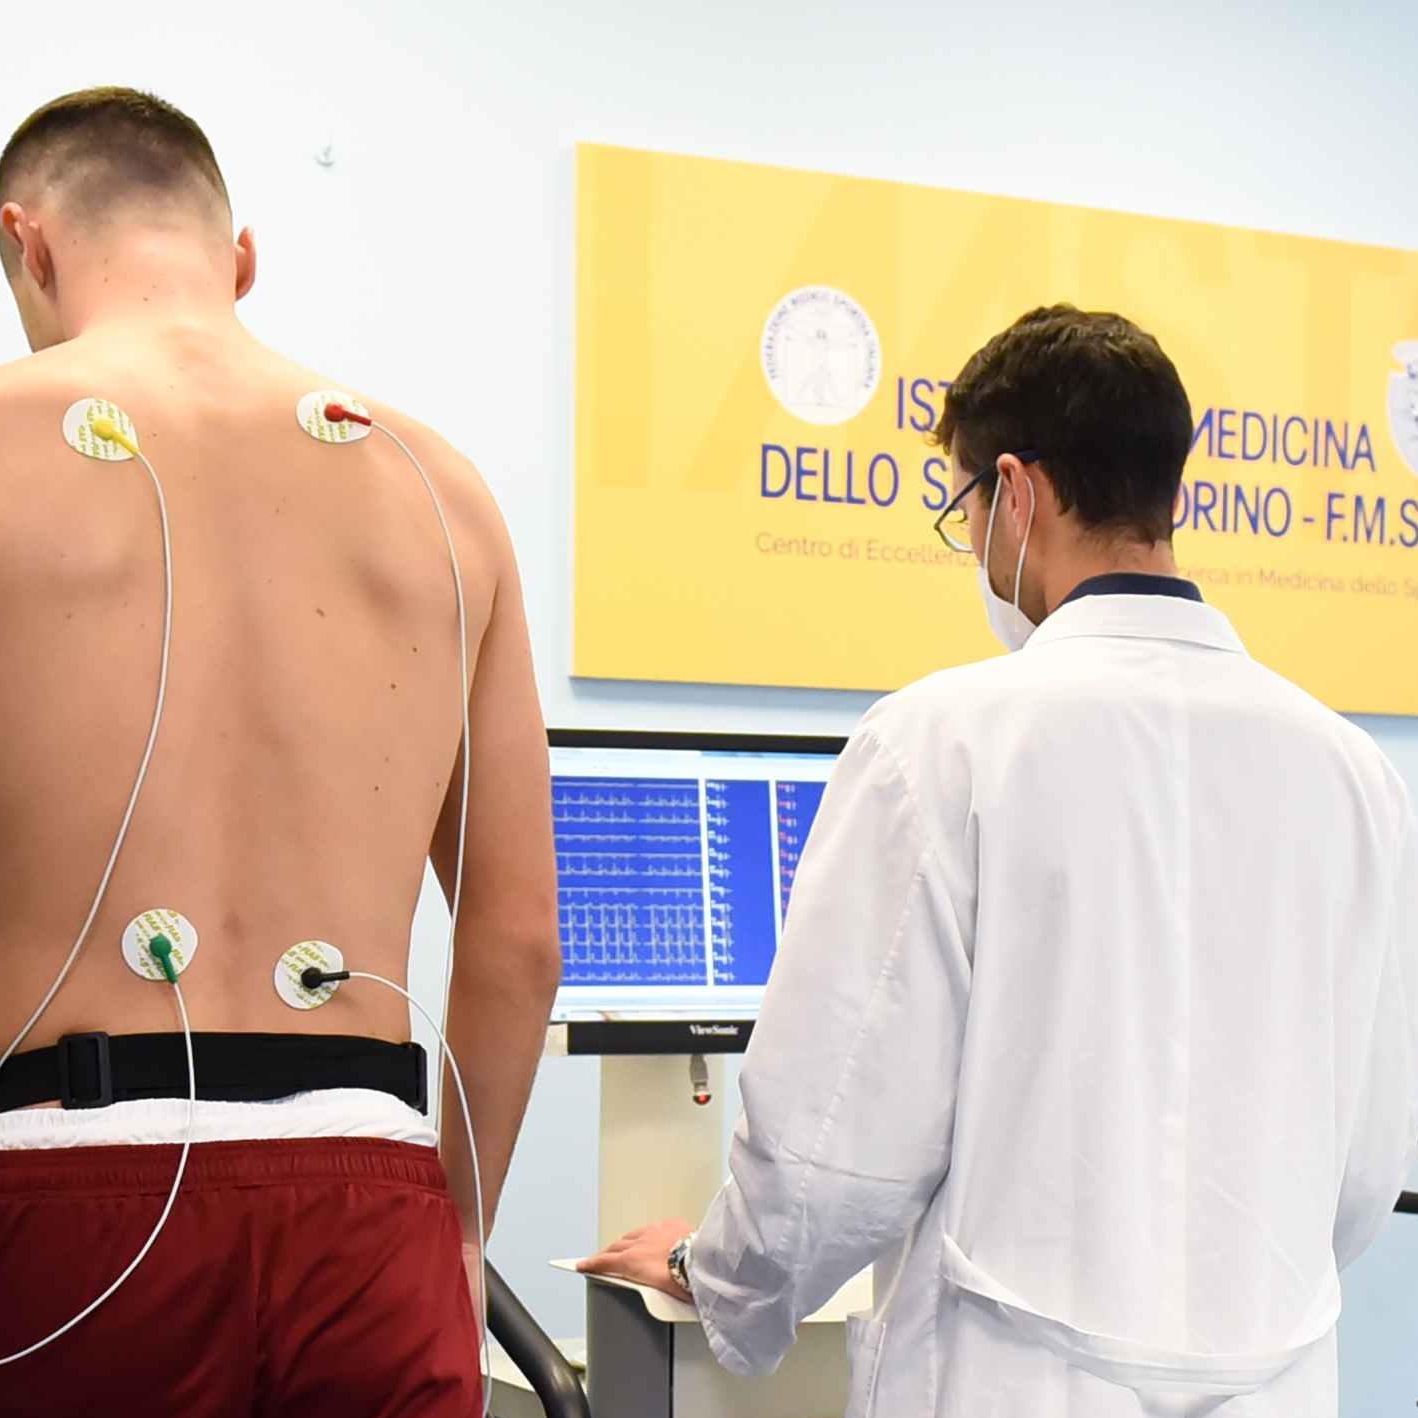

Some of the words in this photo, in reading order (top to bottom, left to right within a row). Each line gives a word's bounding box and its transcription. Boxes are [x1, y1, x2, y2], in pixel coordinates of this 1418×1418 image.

[760, 443, 900, 507] DELLO
[756, 531, 832, 557] Centro
[839, 538, 859, 558] di
[1237, 568, 1253, 584] in
[1259, 568, 1345, 592] Medicina
[1351, 576, 1398, 596] dello
[689, 1024, 740, 1035] ViewSonic
